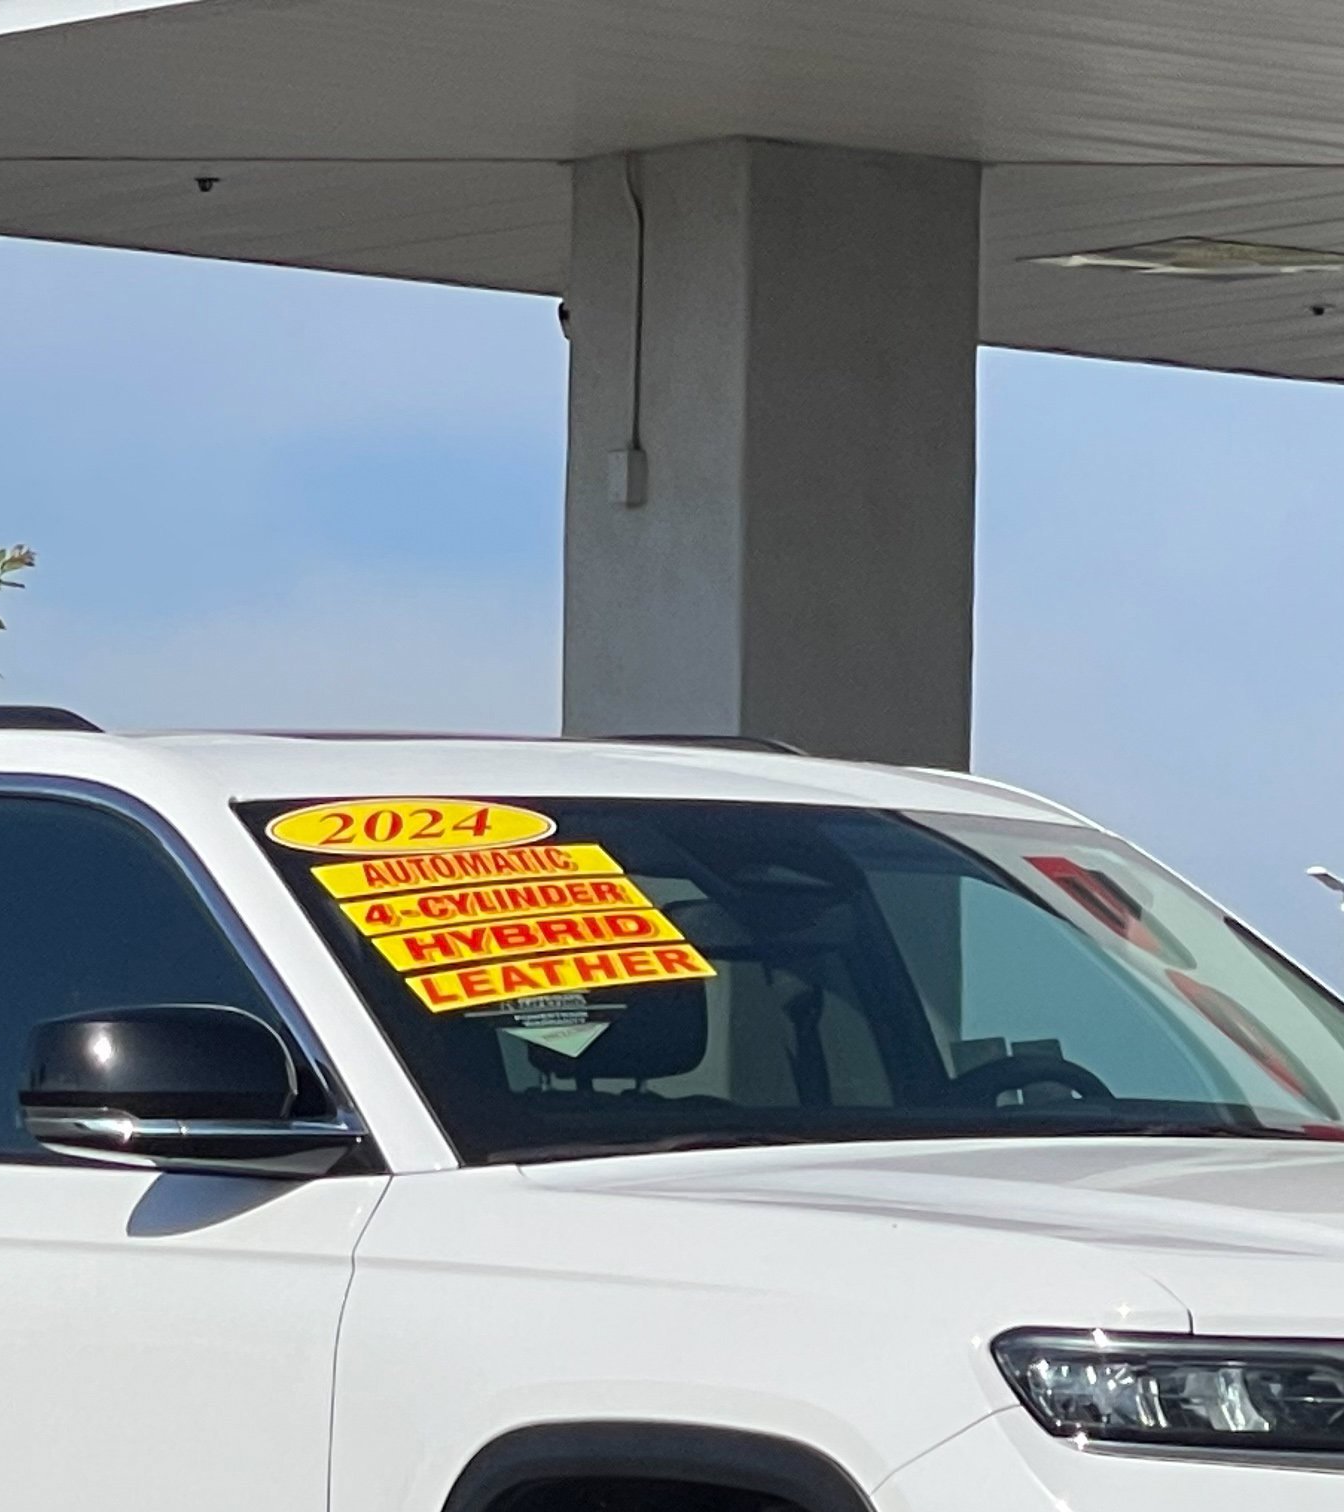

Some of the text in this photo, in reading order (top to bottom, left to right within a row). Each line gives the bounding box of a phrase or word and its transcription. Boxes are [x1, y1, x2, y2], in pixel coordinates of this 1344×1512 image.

[319, 807, 493, 846] 2024
[363, 846, 572, 888] AUTOMATIC
[364, 881, 626, 926] 4-CYLINDER
[403, 913, 653, 963] HYBRID
[421, 947, 700, 1005] LEATHER
